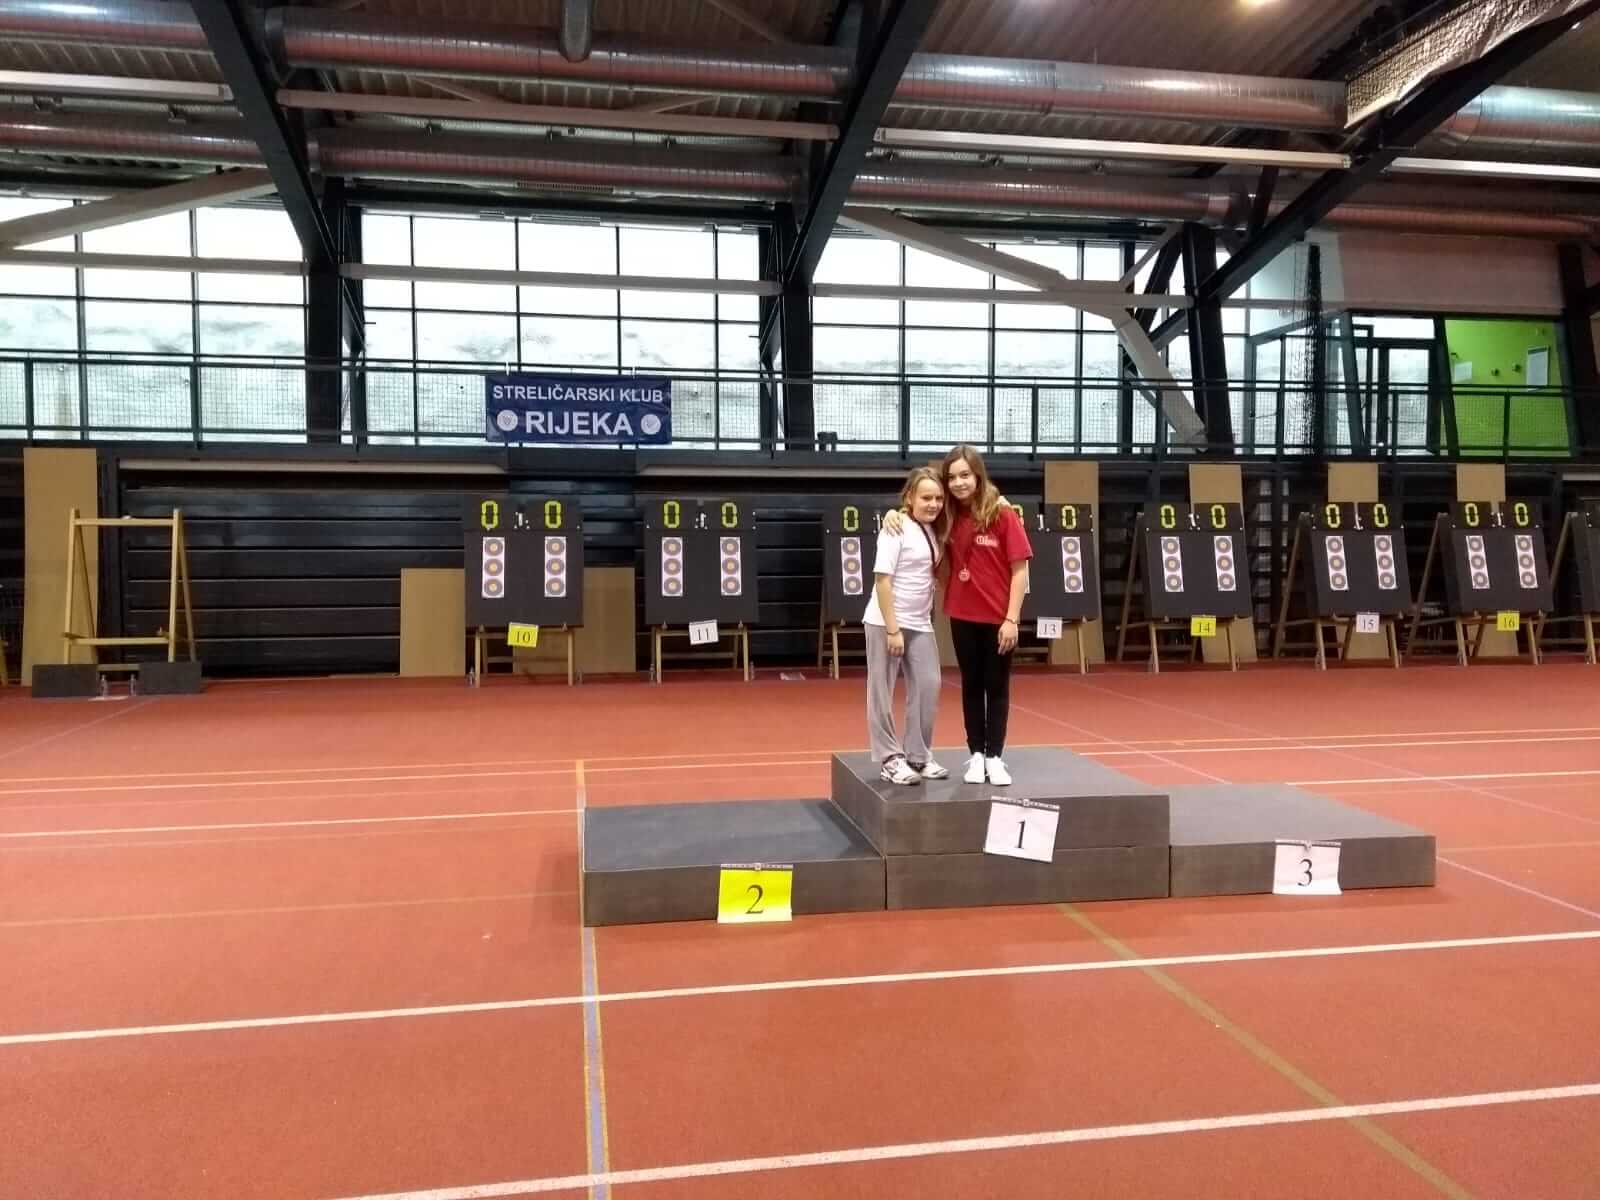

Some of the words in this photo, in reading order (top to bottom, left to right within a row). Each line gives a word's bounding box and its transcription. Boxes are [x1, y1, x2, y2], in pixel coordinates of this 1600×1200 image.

[493, 384, 614, 401] STRELIČARSKI
[620, 388, 663, 403] KLUB
[525, 411, 633, 436] RIJEKA
[481, 501, 498, 529] 0
[544, 501, 562, 529] 0
[663, 501, 680, 528] 0
[721, 502, 738, 528] 0
[843, 506, 859, 532] 0
[1061, 505, 1077, 530] 0
[1160, 504, 1176, 528] 0
[1211, 504, 1226, 528] 0
[1325, 503, 1341, 528] 0
[1374, 503, 1389, 528] 0
[1465, 503, 1479, 527] 0
[1514, 503, 1529, 526] 0
[697, 627, 709, 641] 11
[1042, 623, 1058, 635] 13
[1198, 622, 1210, 633] 14
[1362, 618, 1375, 630] 15
[1503, 617, 1516, 628] 16
[515, 630, 532, 643] 10
[1014, 819, 1026, 849] 1
[1297, 858, 1313, 887] 3
[745, 884, 764, 914] 2
